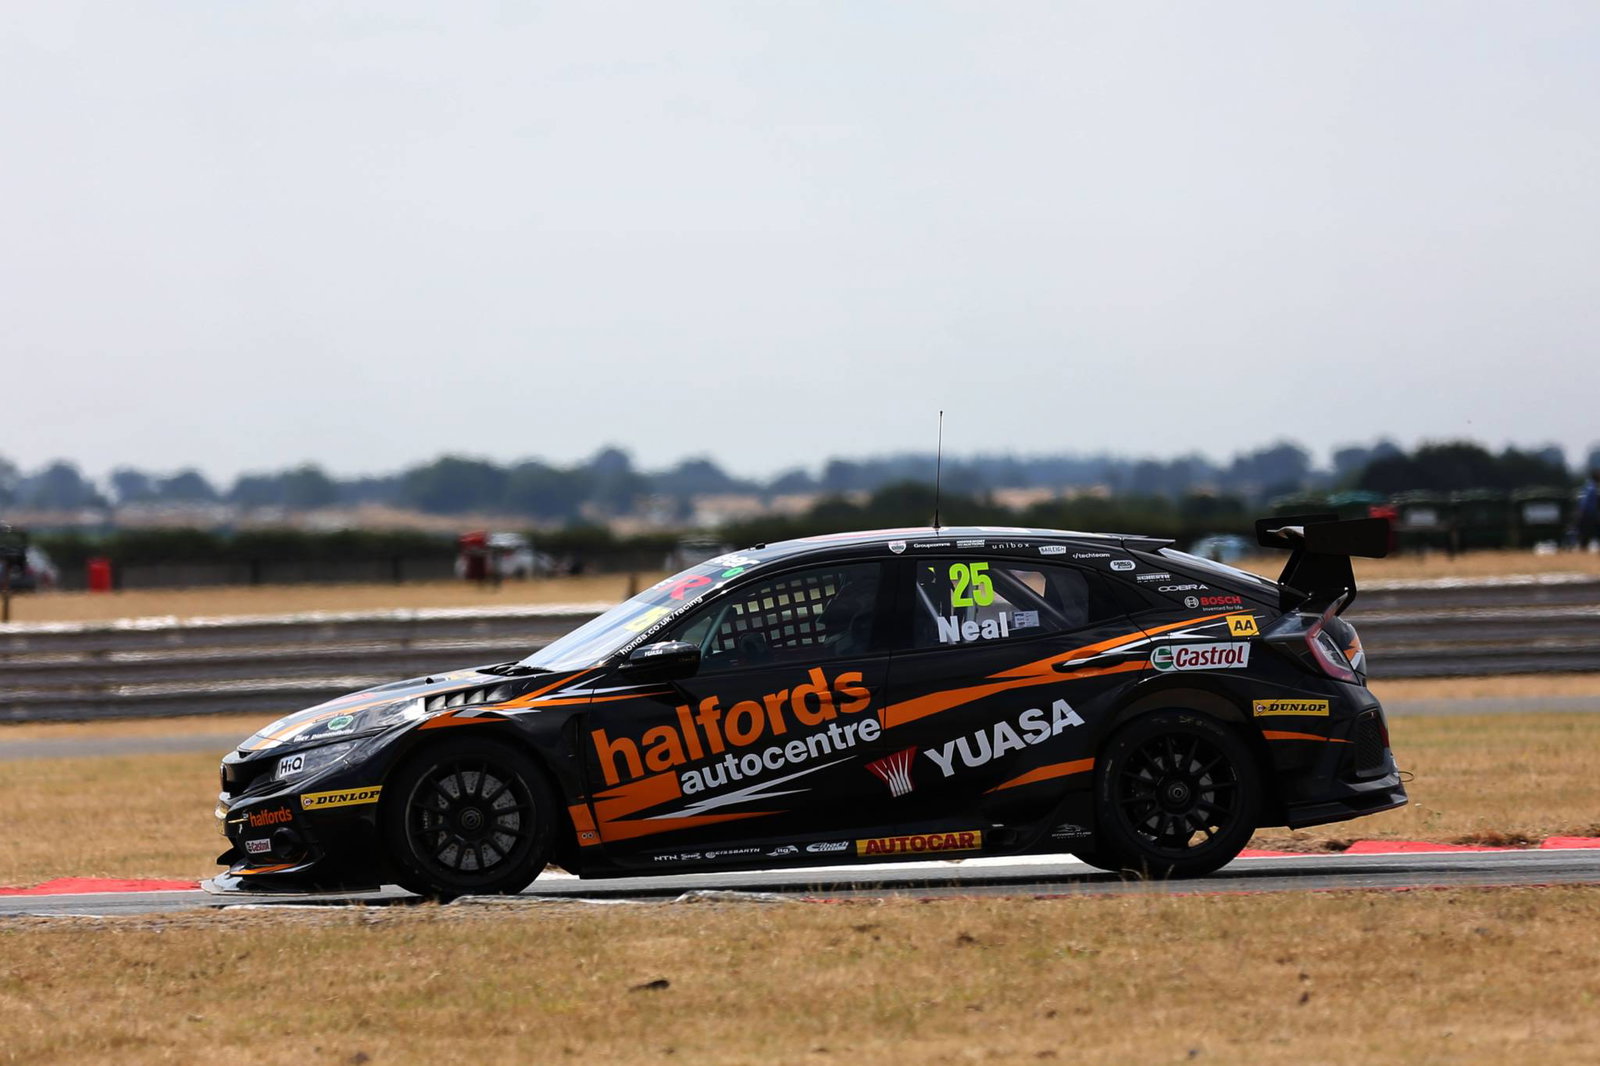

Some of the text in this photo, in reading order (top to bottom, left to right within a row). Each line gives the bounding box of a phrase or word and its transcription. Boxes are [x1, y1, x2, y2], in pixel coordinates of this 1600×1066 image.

[949, 561, 995, 608] 25
[1158, 584, 1209, 592] COBRA
[1200, 596, 1242, 606] BOSCH
[619, 595, 704, 655] honda.co.uk/racing
[937, 612, 1009, 643] Neal
[1233, 620, 1254, 631] AA
[1175, 645, 1244, 667] Castrol
[1268, 703, 1327, 712] DUNLOP
[591, 667, 871, 786] halfords
[923, 698, 1085, 778] YUASA
[280, 757, 303, 774] HiQ
[680, 718, 881, 795] autocentre
[316, 790, 381, 804] DUNLOP
[249, 807, 293, 827] halfords
[865, 831, 975, 855] AUTOCAR
